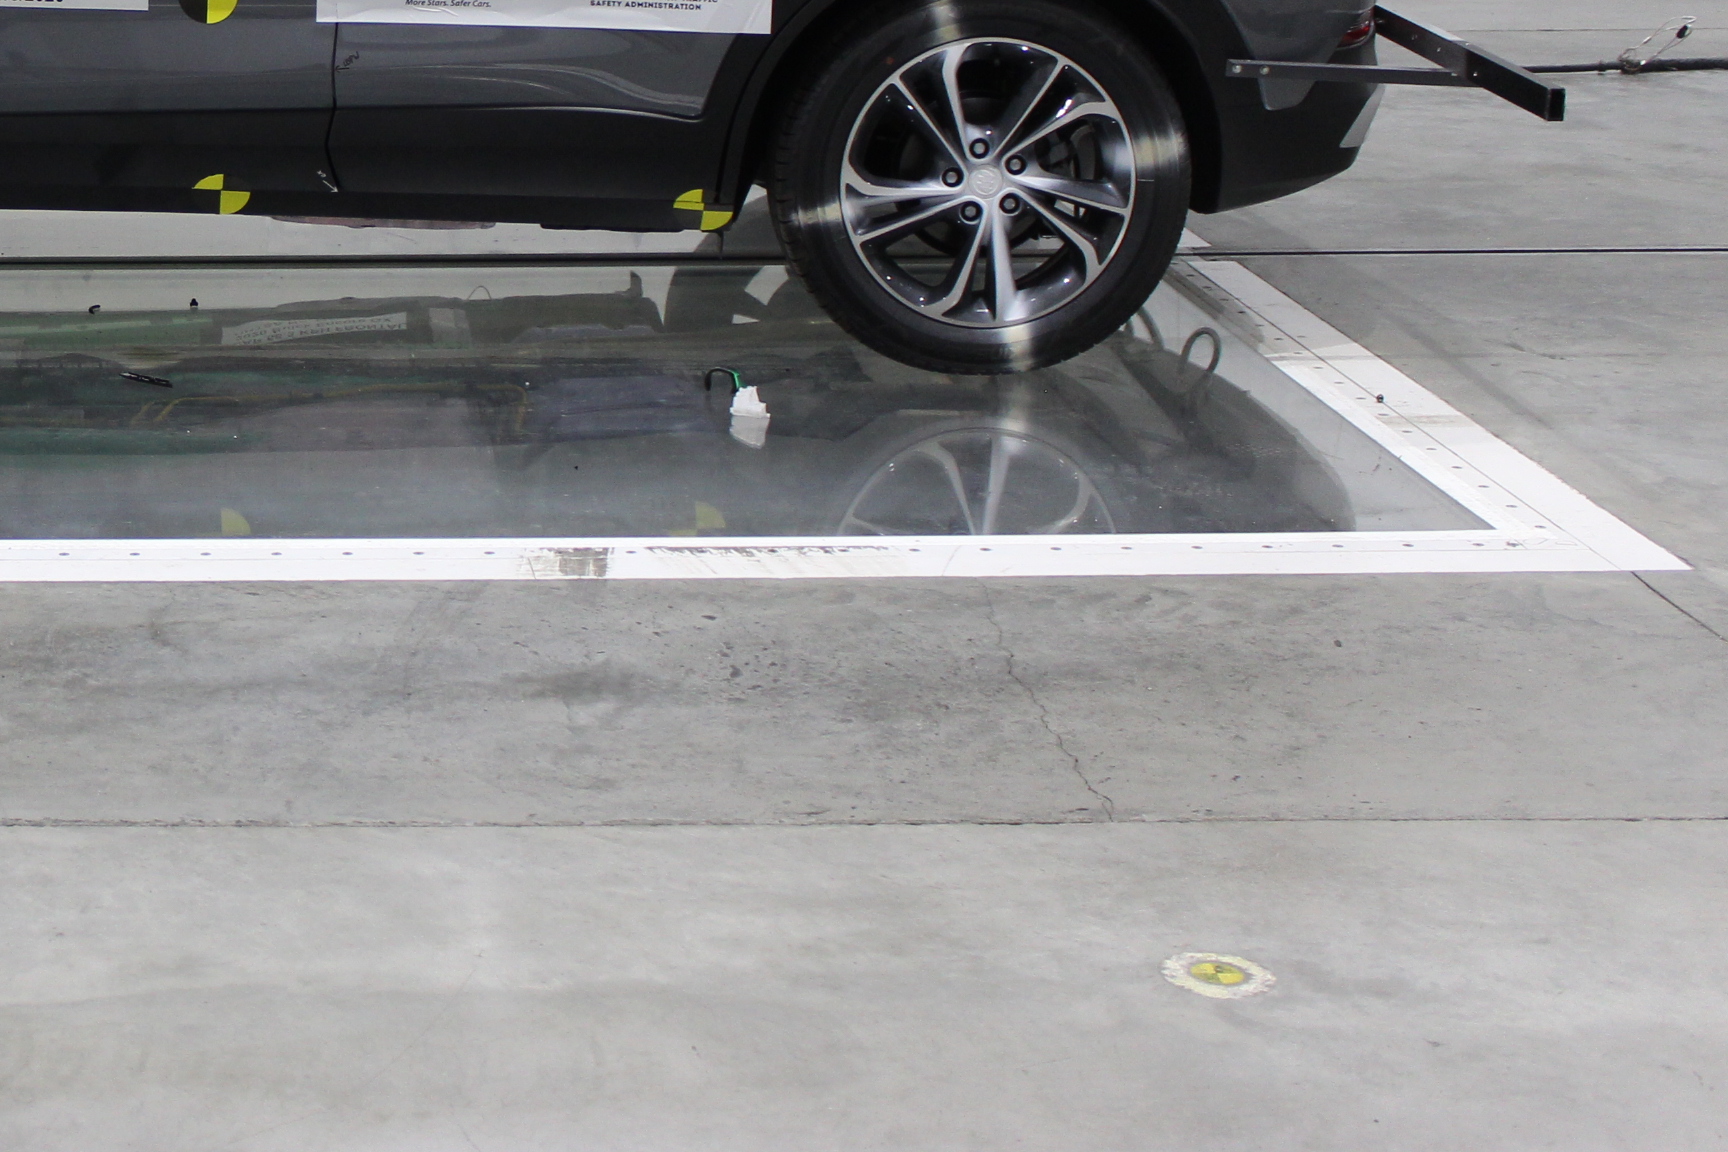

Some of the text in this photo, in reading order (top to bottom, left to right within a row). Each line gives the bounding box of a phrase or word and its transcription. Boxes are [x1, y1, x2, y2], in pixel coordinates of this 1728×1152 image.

[427, 0, 449, 7] Stars.
[450, 0, 471, 7] Safer
[472, 0, 492, 8] Cars.
[625, 1, 701, 10] ADMINISTRATION
